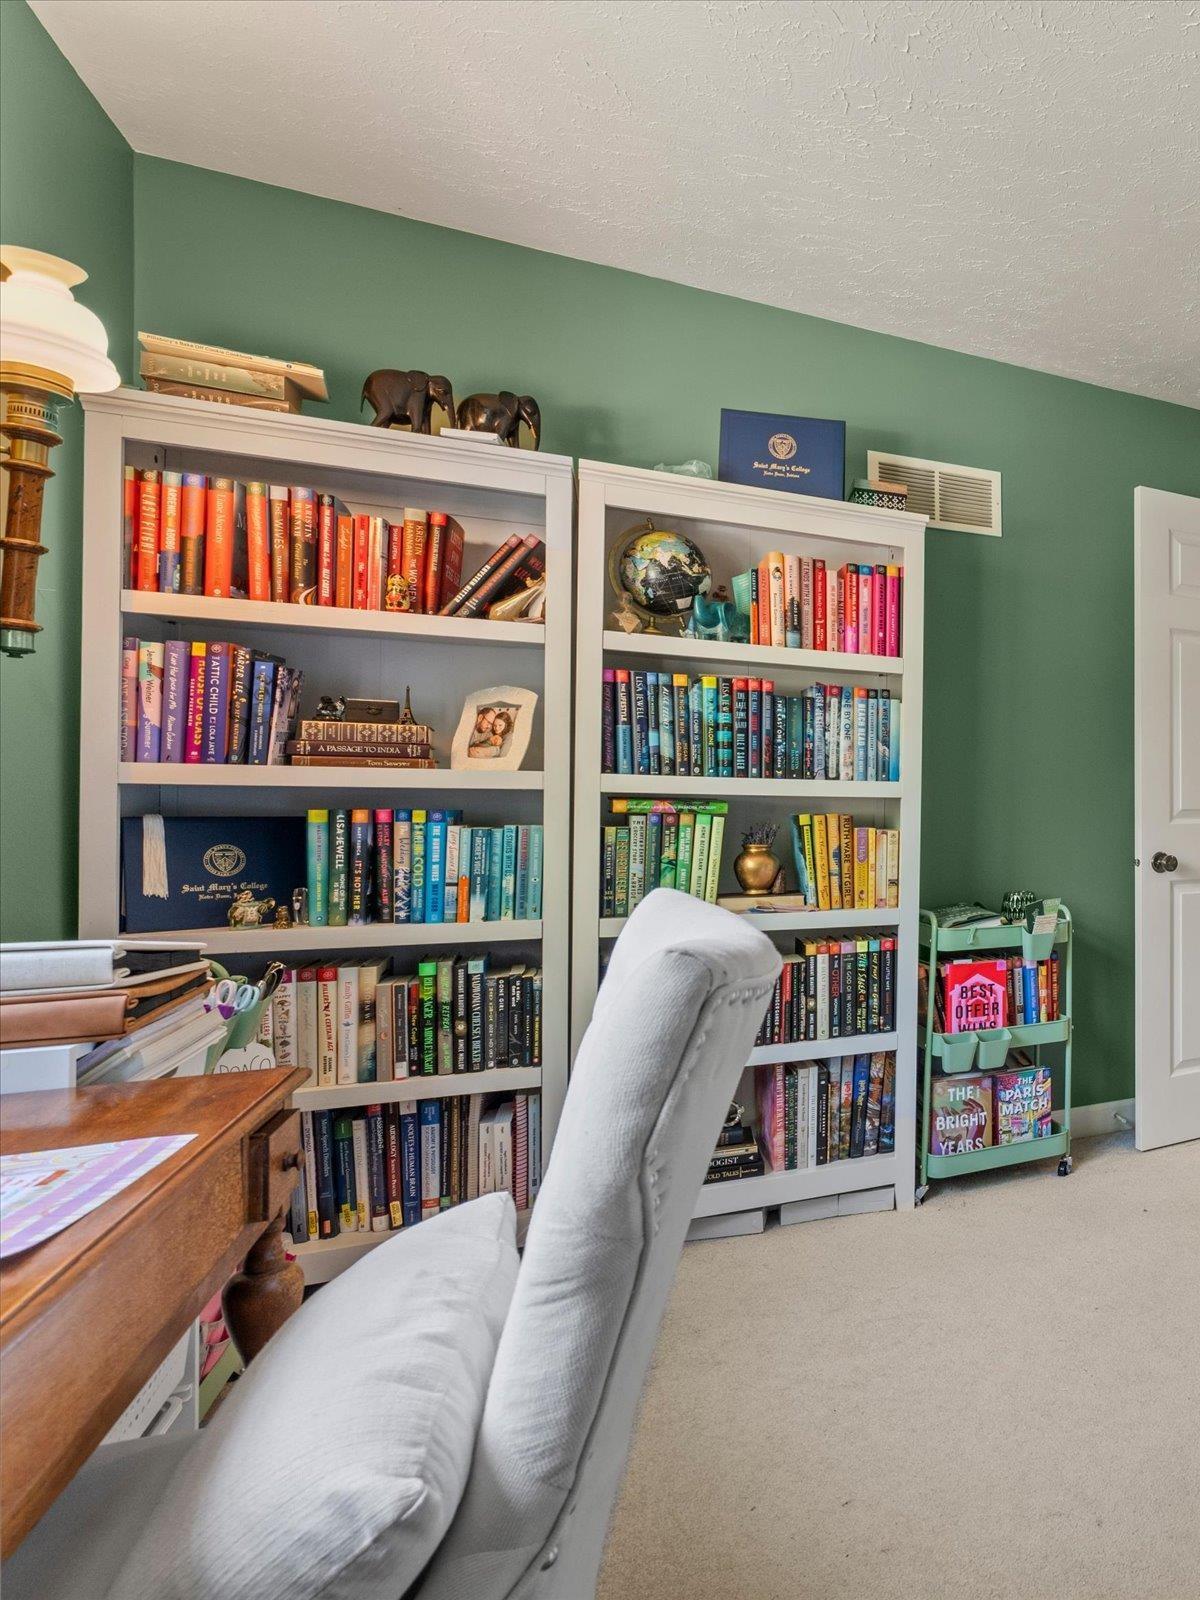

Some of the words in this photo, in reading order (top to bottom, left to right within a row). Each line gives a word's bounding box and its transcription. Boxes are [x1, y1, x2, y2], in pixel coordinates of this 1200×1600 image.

[752, 461, 768, 470] Saint
[770, 462, 790, 472] Mary's
[791, 465, 811, 475] College
[142, 494, 156, 518] LAST
[167, 488, 178, 516] ARSENIC
[216, 494, 224, 513] Liane
[274, 503, 282, 515] THE
[294, 502, 302, 538] HANNAH
[304, 504, 312, 538] KRISTIN
[142, 521, 155, 555] FLIGHT
[274, 520, 284, 549] WIVES
[406, 522, 414, 556] HANNAH
[415, 524, 424, 556] KRISTIN
[408, 569, 418, 602] WOMEN
[456, 586, 472, 603] RITTER
[804, 598, 810, 606] US
[210, 660, 218, 686] ATTIC
[236, 650, 244, 680] HARPER
[145, 680, 154, 704] Weiner
[635, 676, 644, 692] LISA
[722, 682, 730, 698] LISA
[209, 687, 218, 714] CHILD
[662, 686, 670, 706] ALICE
[844, 691, 852, 708] ONE
[636, 694, 644, 719] JEWELL
[722, 700, 730, 724] JEWELL
[844, 711, 851, 720] BY
[858, 704, 866, 727] BEACH
[144, 720, 154, 749] Summer
[194, 714, 204, 746] GLASS
[858, 728, 866, 746] READ
[318, 745, 325, 754] A
[326, 745, 362, 754] PASSAGE
[364, 746, 376, 754] TO
[377, 746, 401, 754] INDIA
[366, 760, 382, 768] Tom
[336, 814, 344, 834] LISA
[432, 826, 441, 836] THE
[335, 836, 344, 869] JEWELL
[398, 838, 410, 864] Wedding
[432, 838, 441, 862] HUNTING
[474, 836, 482, 860] ARCHER'S
[505, 834, 514, 854] STARTS
[354, 860, 362, 874] IT'S
[412, 857, 424, 887] COLD
[432, 864, 440, 882] WIVES
[181, 884, 204, 894] Saint
[206, 882, 238, 895] Mary's
[240, 882, 268, 892] College
[354, 876, 362, 892] NOT
[858, 953, 866, 972] RILEY
[322, 984, 330, 1003] KILLERS
[343, 981, 352, 1000] Emily
[424, 978, 433, 997] RILEY
[472, 974, 480, 1011] MADWOMAN
[832, 970, 840, 997] OTHER
[858, 974, 866, 994] SAGER
[961, 984, 995, 1000] BEST
[424, 997, 433, 1018] SAGER
[956, 1002, 1000, 1020] OFFER
[442, 1006, 450, 1032] RETREAT
[472, 1012, 480, 1040] CHELSEA
[958, 1020, 997, 1032] WINS
[472, 1040, 480, 1064] BIEKER
[424, 1054, 434, 1073] NIGHT
[1017, 1076, 1034, 1085] THE
[948, 1086, 973, 1102] THE
[1008, 1084, 1046, 1101] PARIS
[1002, 1099, 1047, 1116] MATCH
[936, 1112, 987, 1131] BRIGHT
[320, 1134, 329, 1152] Speech
[940, 1138, 984, 1156] YEARS
[322, 1153, 330, 1177] Disorders
